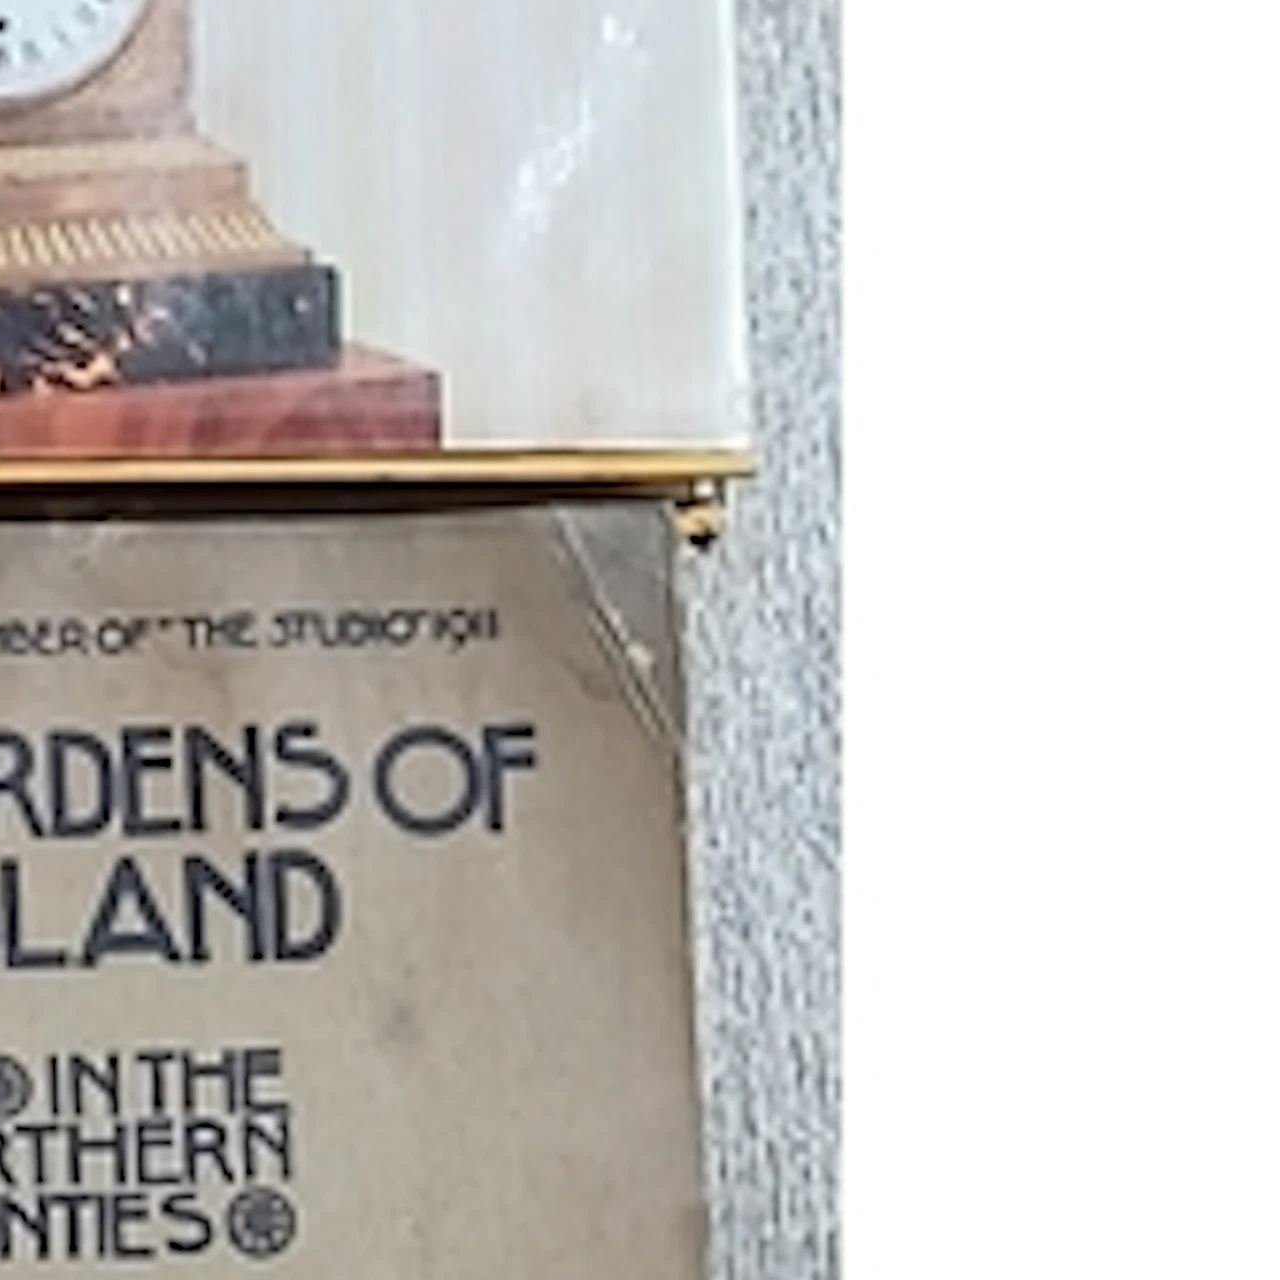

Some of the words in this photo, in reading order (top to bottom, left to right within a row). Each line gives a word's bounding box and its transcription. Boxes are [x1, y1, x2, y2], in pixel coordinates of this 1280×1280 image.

[372, 723, 536, 837] OF
[48, 1054, 120, 1115] IN
[135, 1047, 289, 1117] THE
